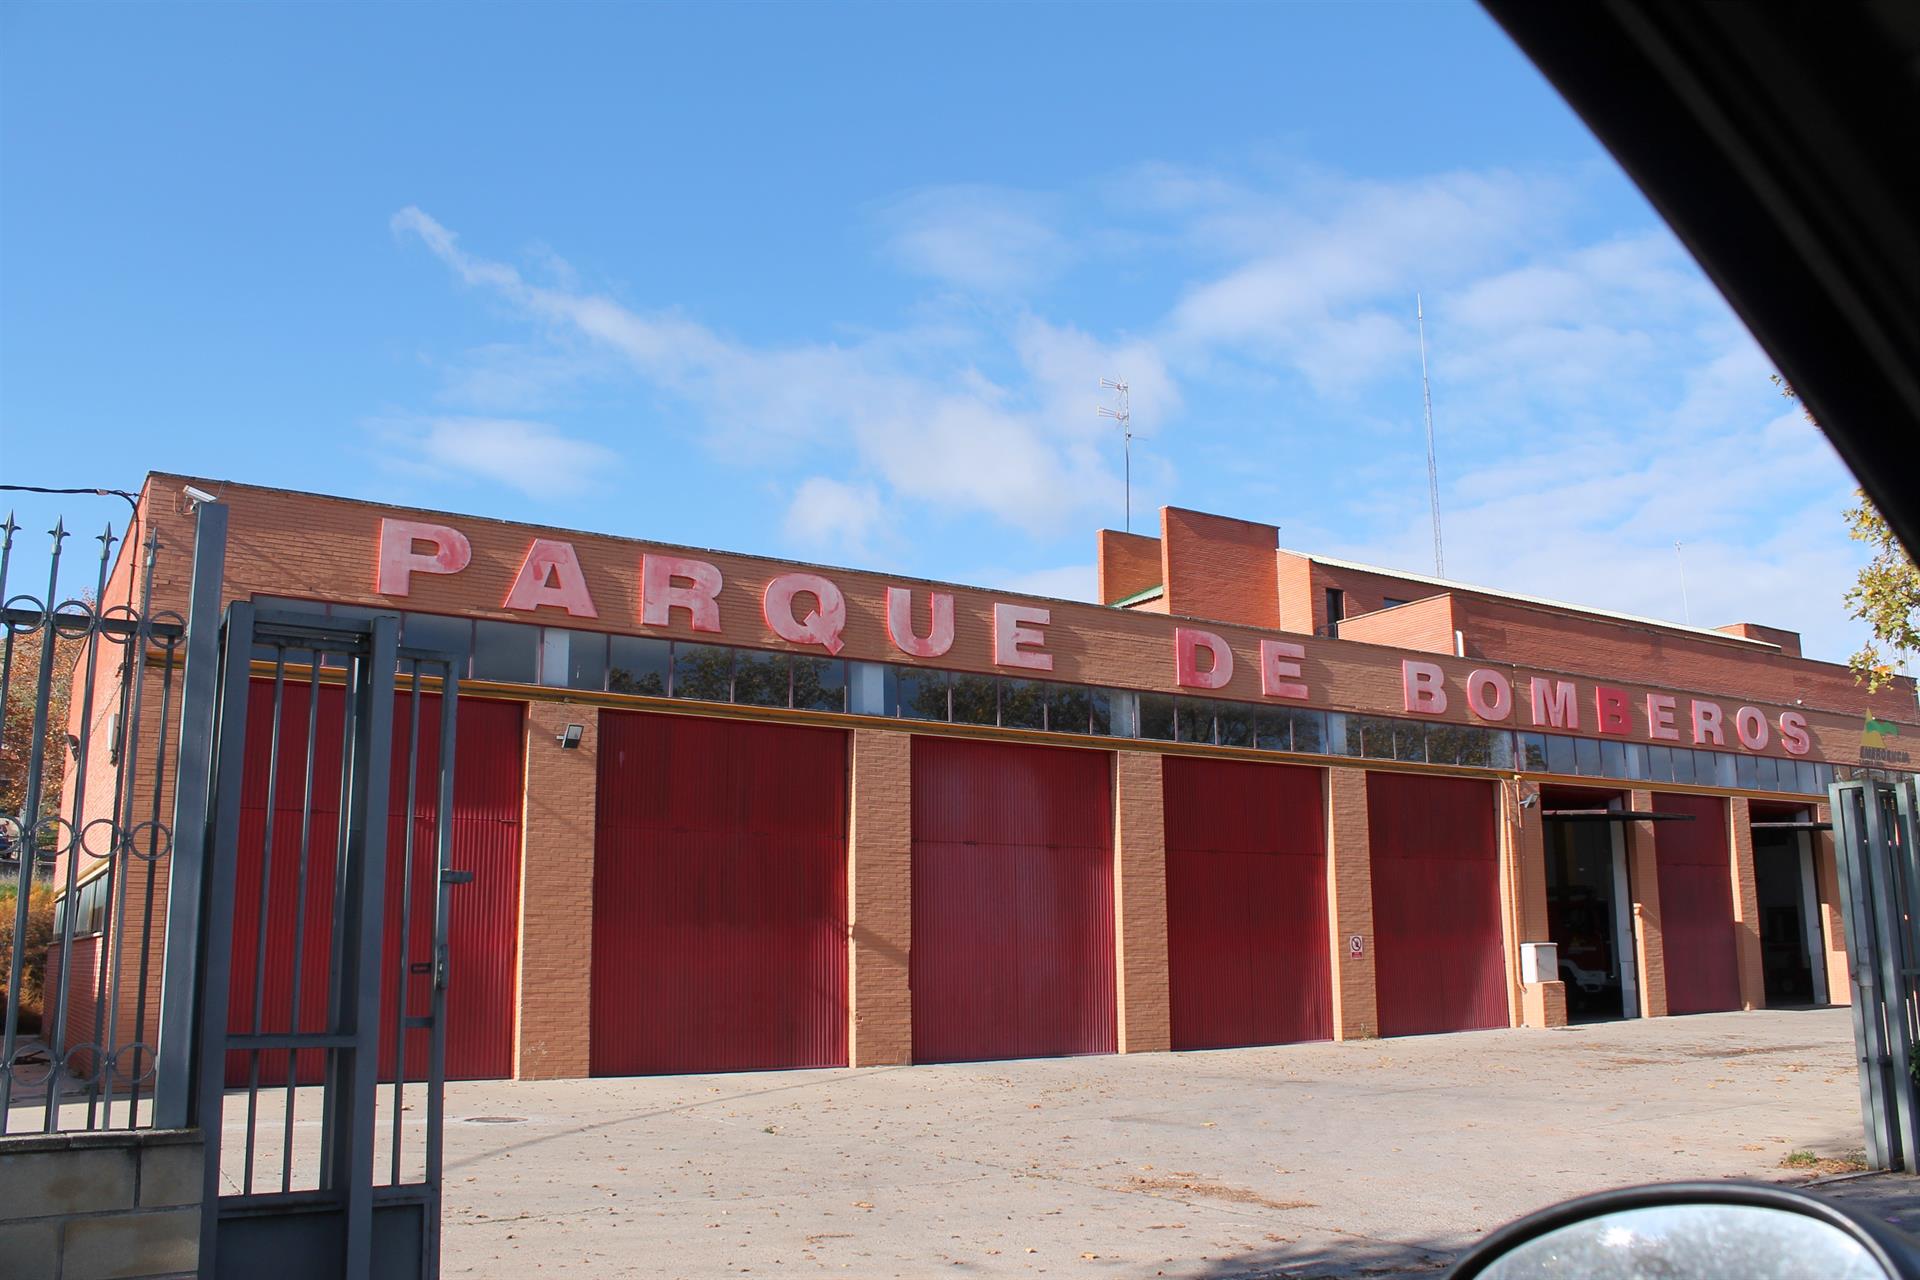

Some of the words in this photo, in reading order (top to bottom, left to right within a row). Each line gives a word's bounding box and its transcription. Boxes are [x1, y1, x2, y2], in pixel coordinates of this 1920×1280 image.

[376, 518, 1053, 671] PARQUE
[1174, 627, 1309, 699] DE
[1402, 658, 1811, 755] BOMBEROS
